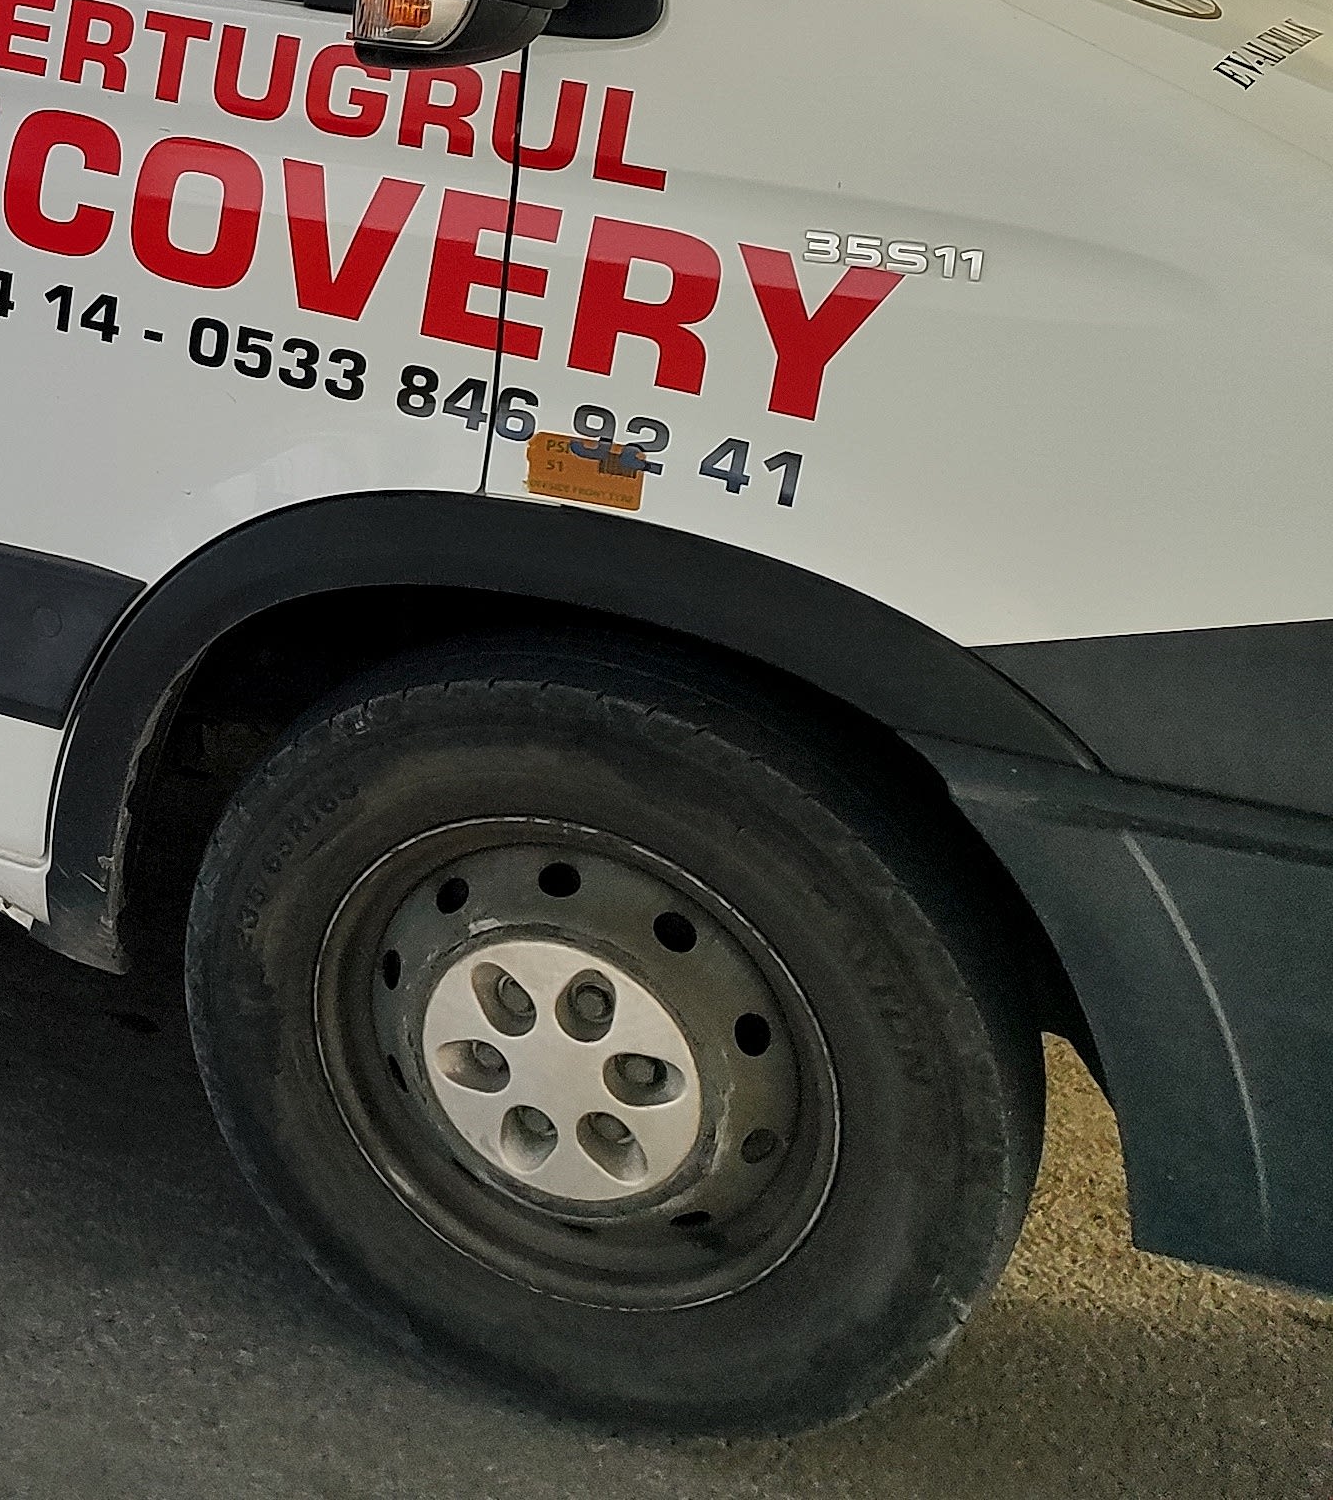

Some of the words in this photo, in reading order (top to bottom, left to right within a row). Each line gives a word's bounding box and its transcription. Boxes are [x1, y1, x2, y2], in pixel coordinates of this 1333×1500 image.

[803, 229, 984, 282] 35S11
[44, 284, 120, 344] 14
[188, 317, 367, 401] 0533
[396, 364, 536, 442] 846
[573, 404, 670, 476] 92
[698, 437, 803, 508] 41
